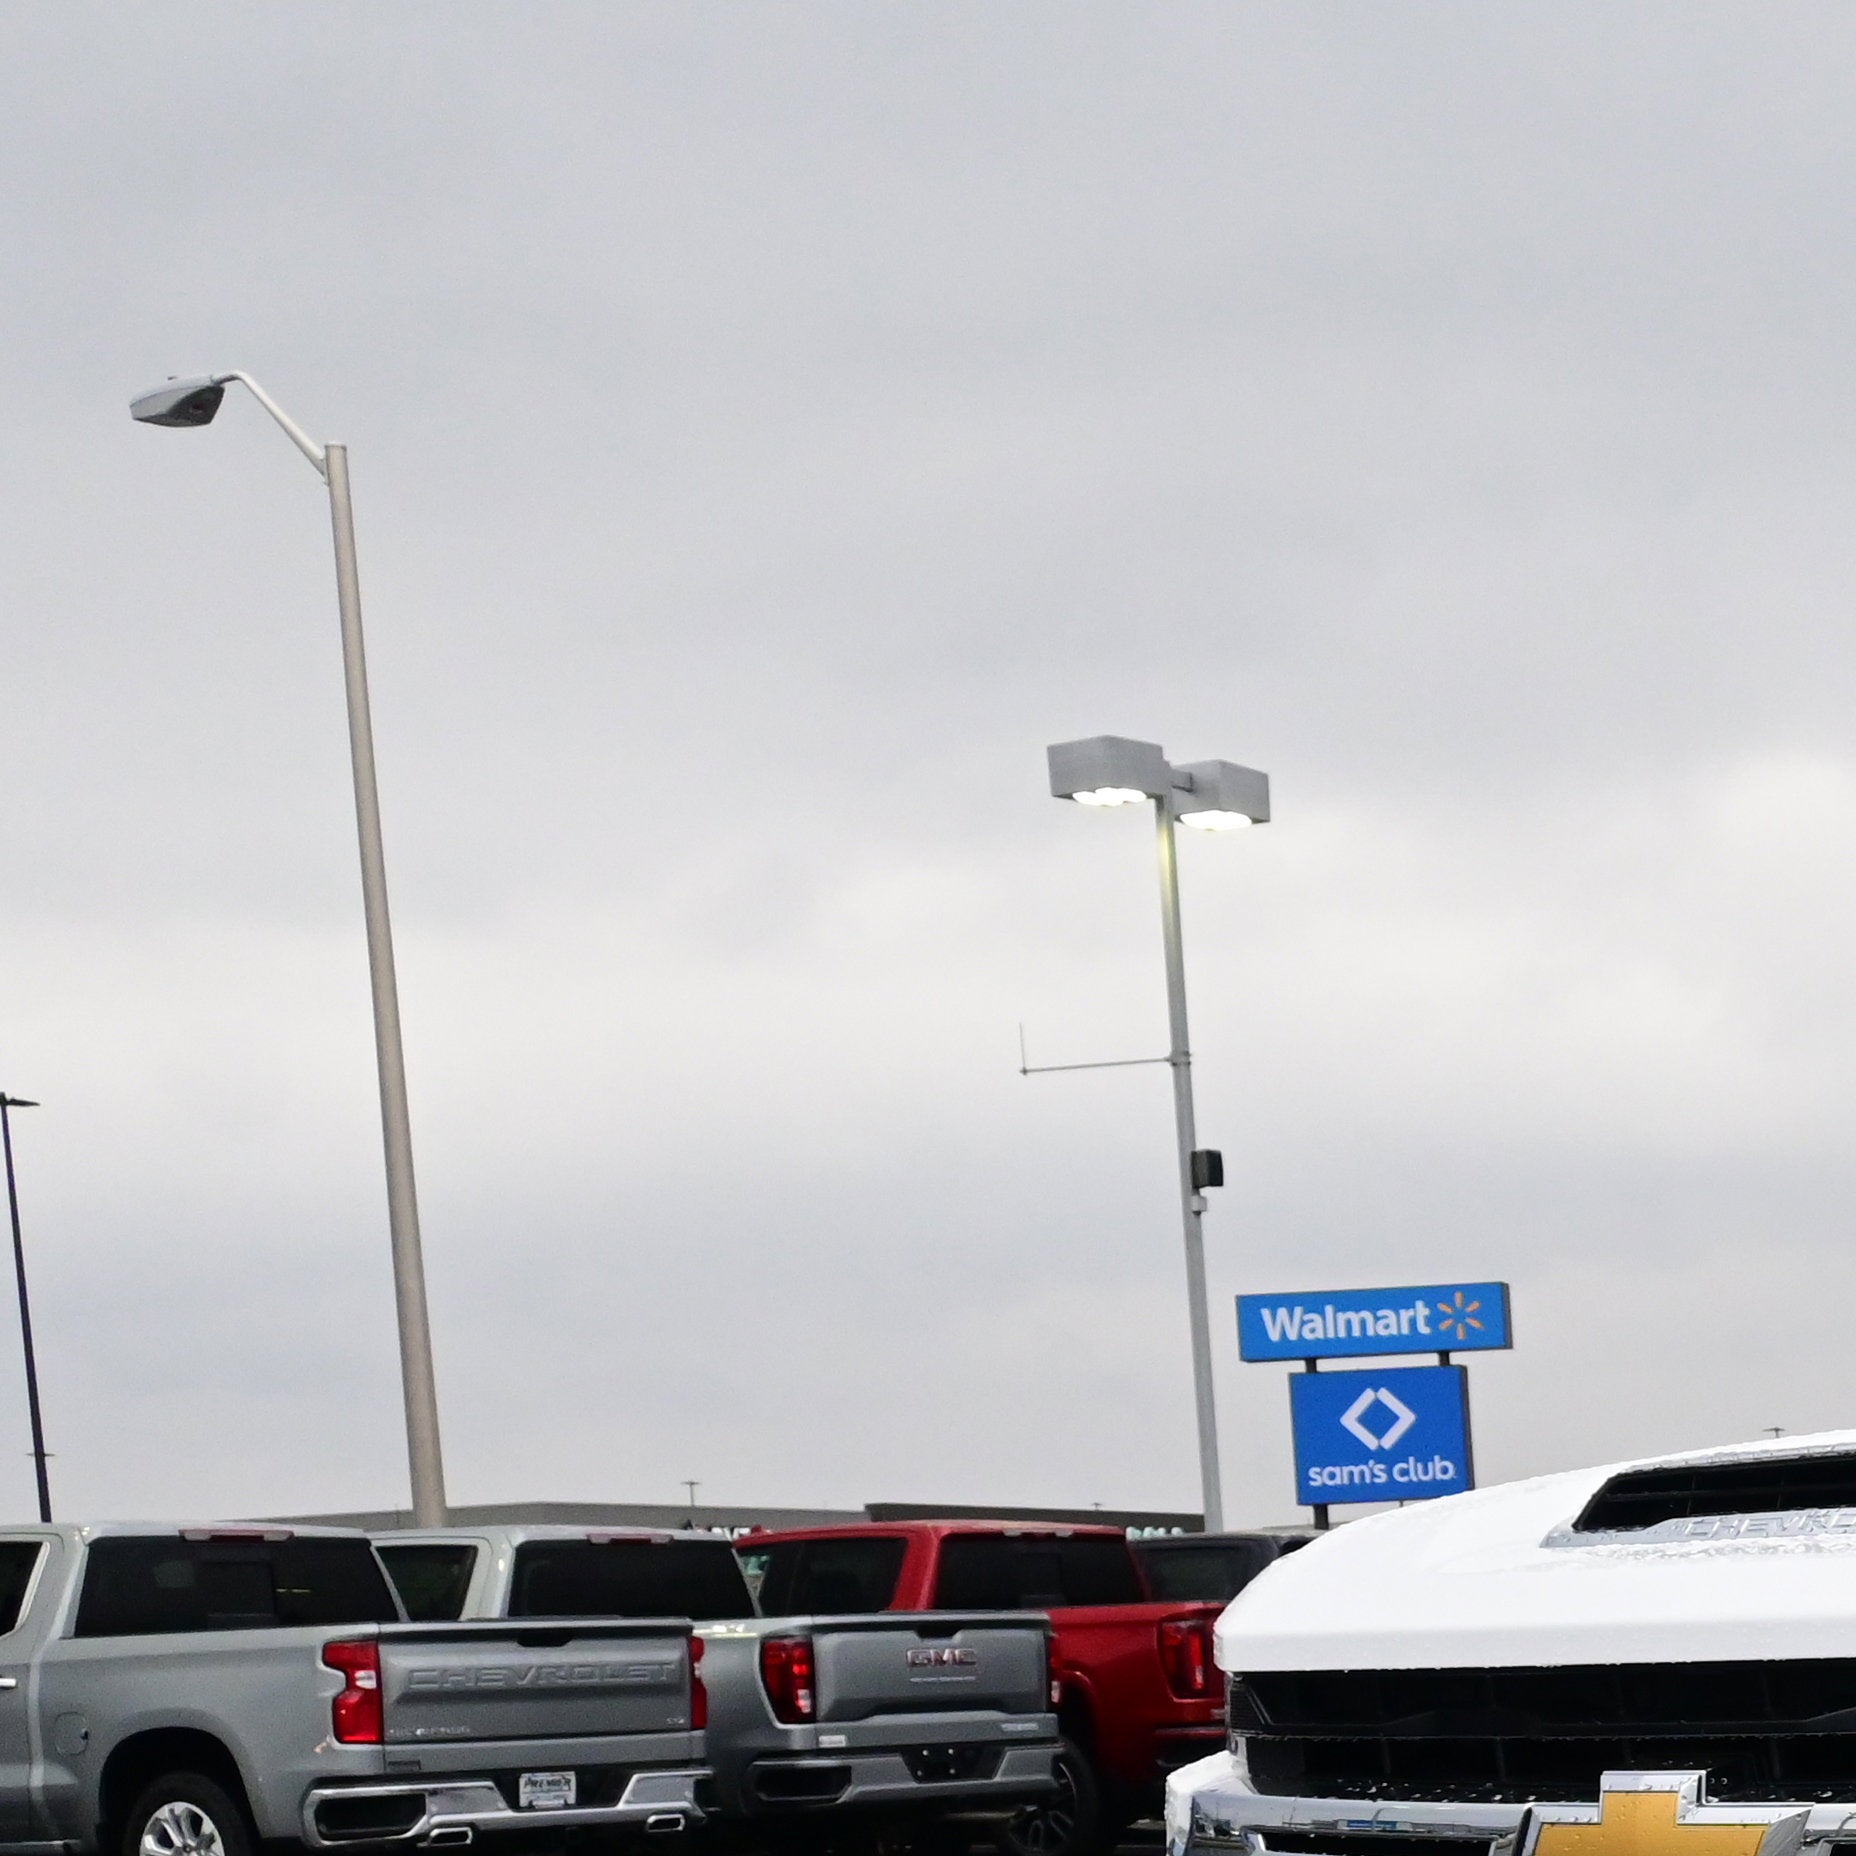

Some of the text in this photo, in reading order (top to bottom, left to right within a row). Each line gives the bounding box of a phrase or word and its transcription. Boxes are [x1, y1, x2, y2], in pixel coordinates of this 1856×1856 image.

[1260, 1300, 1431, 1342] Walmart
[1308, 1456, 1454, 1487] sam's club
[906, 1648, 977, 1667] GMC
[407, 1662, 677, 1690] CHEVROLET
